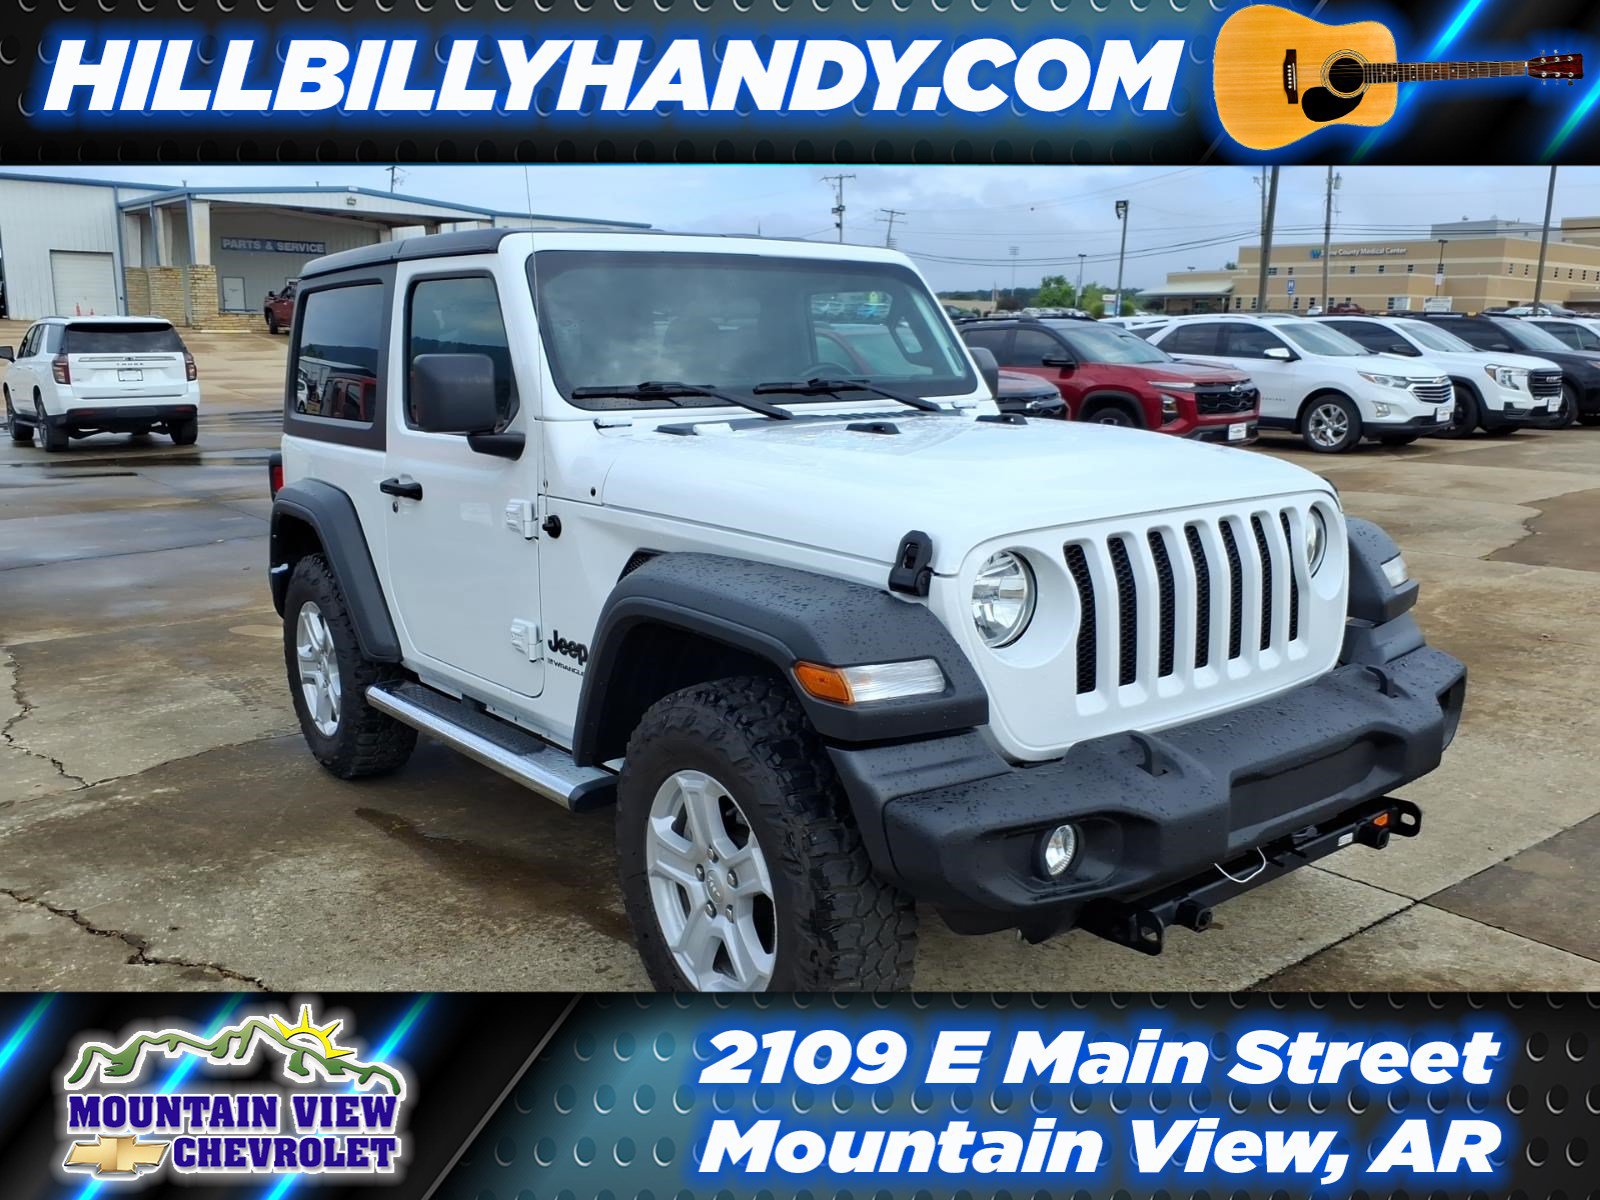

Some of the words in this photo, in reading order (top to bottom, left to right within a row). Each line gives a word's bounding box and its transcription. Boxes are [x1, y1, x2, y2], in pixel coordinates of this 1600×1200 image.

[222, 239, 260, 250] PARTS
[265, 241, 274, 250] &
[276, 242, 325, 253] SERVICE
[1360, 247, 1385, 256] Medical
[1385, 247, 1407, 256] Center
[548, 629, 588, 666] Jeep
